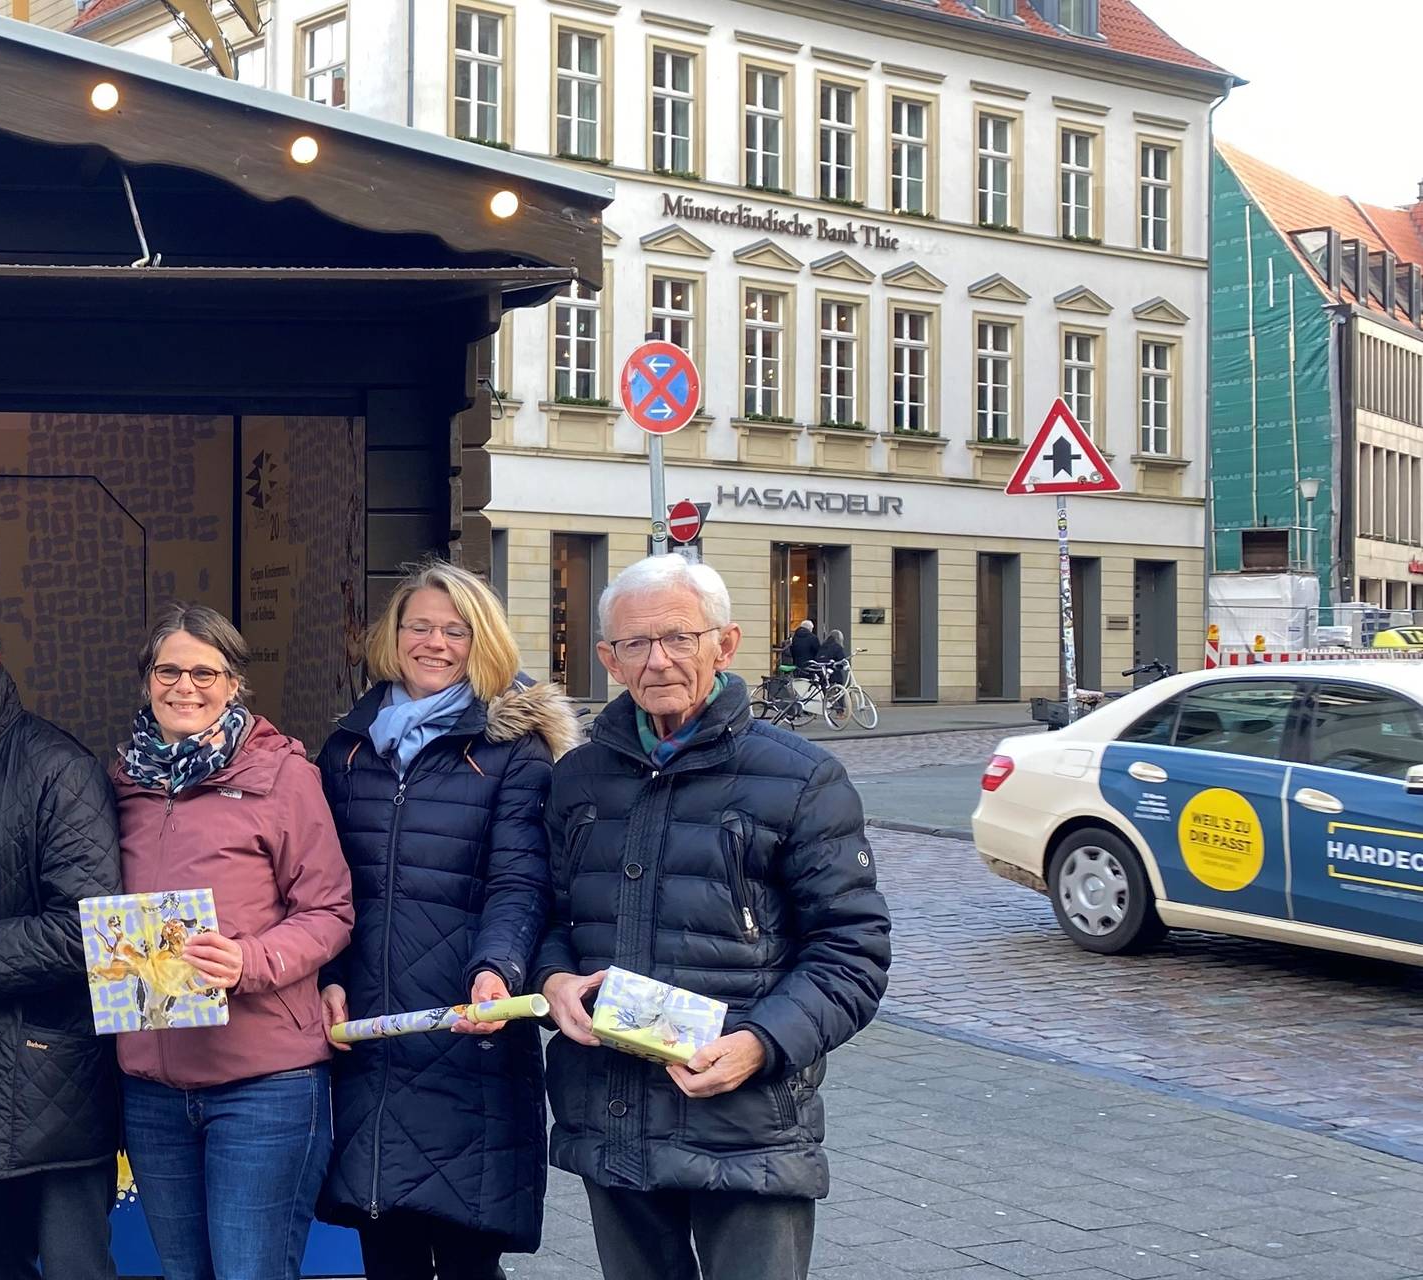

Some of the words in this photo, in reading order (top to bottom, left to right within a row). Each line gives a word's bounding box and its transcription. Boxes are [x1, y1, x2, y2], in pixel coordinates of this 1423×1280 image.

[662, 193, 812, 237] Münsterländische
[817, 217, 857, 244] Bank
[860, 224, 900, 251] Thie
[717, 485, 904, 515] HASARDEUR
[1190, 812, 1232, 830] WEIL'S
[1234, 820, 1252, 834] ZU
[1189, 829, 1210, 844] DIR
[1213, 834, 1252, 853] PASST
